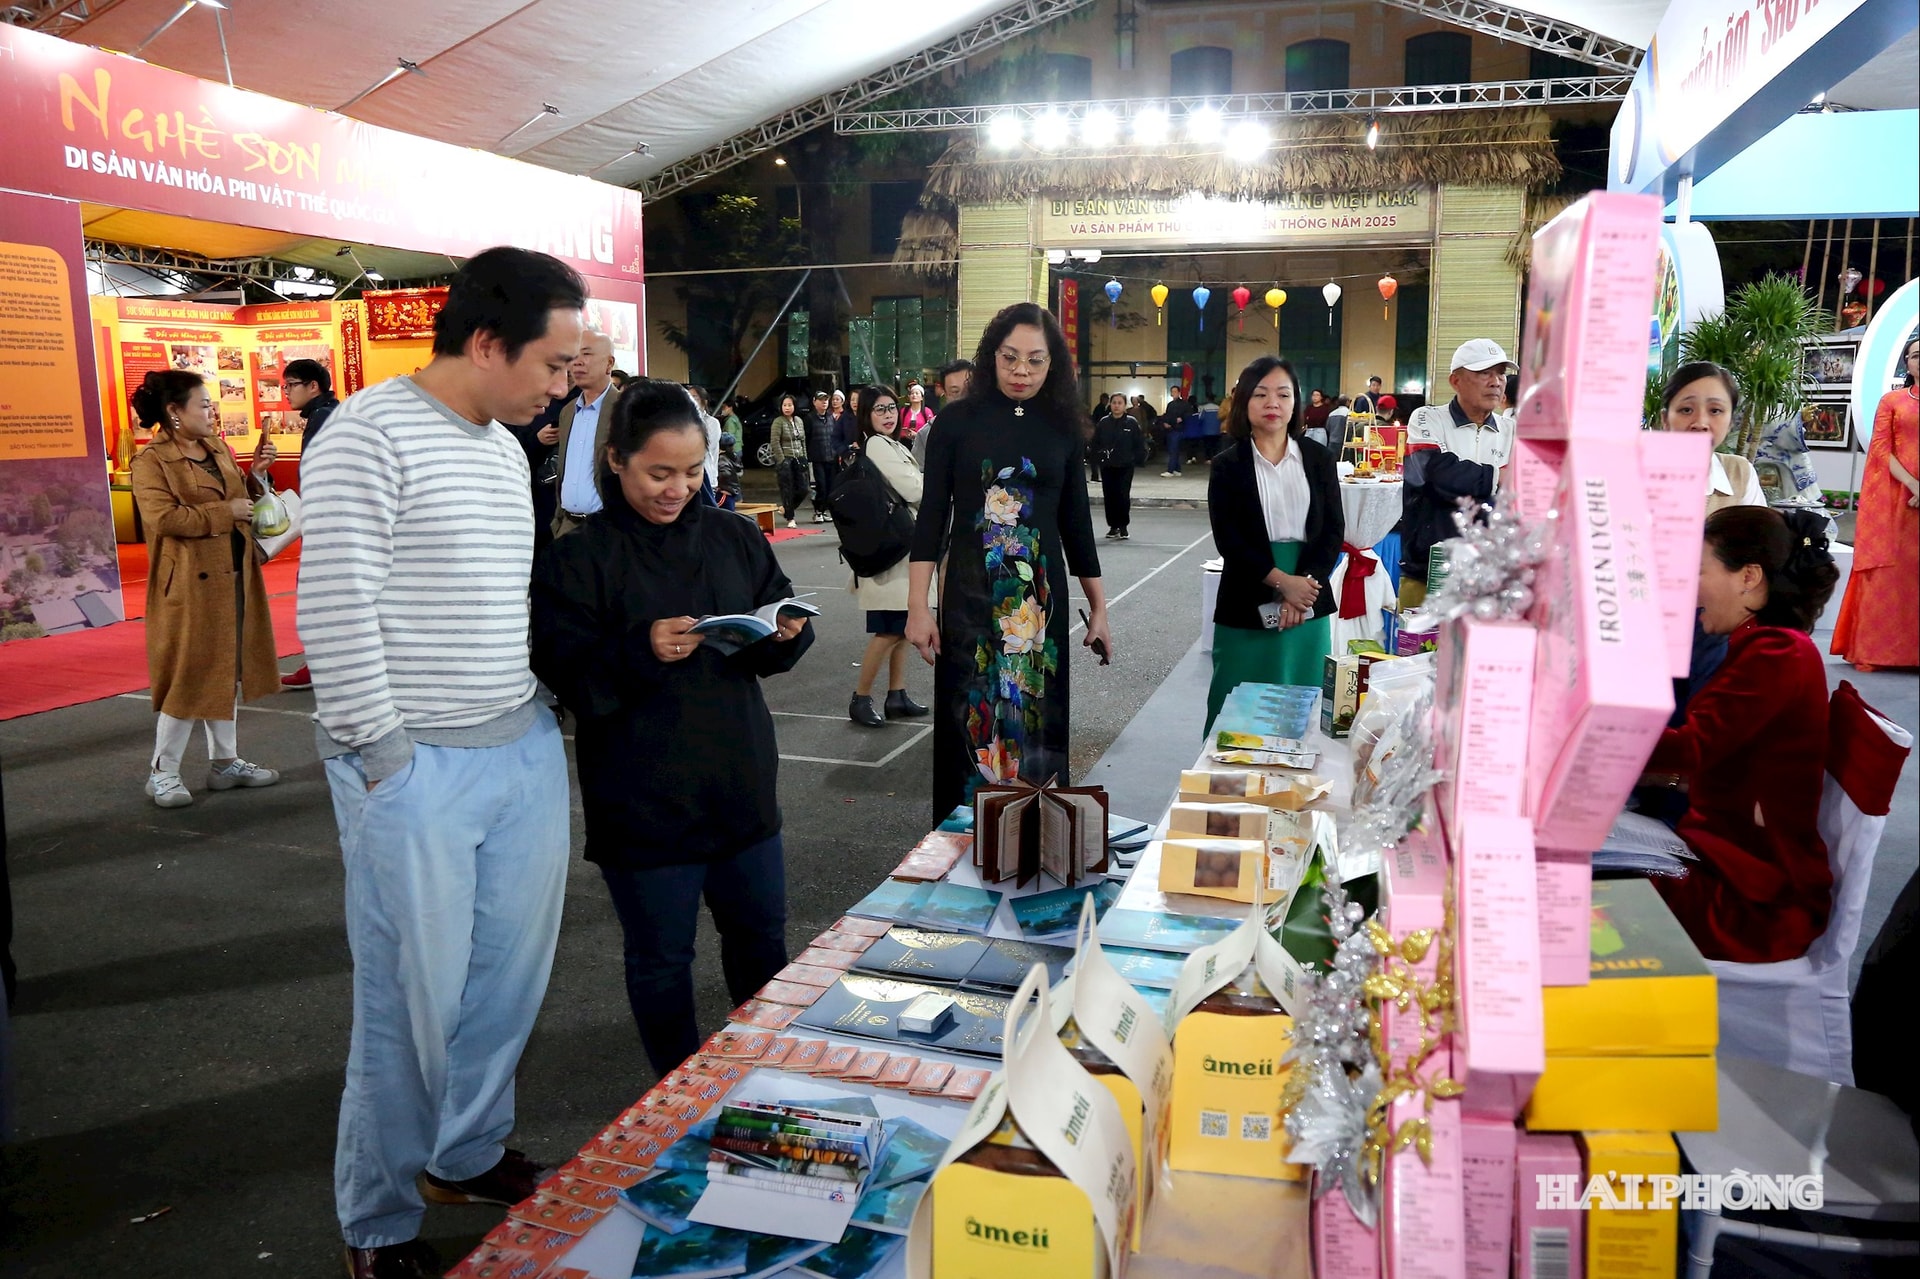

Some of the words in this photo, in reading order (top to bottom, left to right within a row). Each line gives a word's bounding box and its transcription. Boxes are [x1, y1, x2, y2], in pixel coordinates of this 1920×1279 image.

[64, 145, 89, 171] DI
[91, 149, 138, 180] SẢN
[139, 160, 184, 189] VĂN
[185, 166, 227, 196] HÓA
[228, 177, 257, 202] PHI
[258, 182, 295, 210] VẬT
[1051, 199, 1069, 216] DI
[1376, 189, 1418, 208] NAM
[1070, 221, 1087, 235] VÀ
[1090, 220, 1115, 234] SẢN
[1118, 217, 1154, 234] PHẨM
[1280, 213, 1328, 230] THỐNG
[1331, 215, 1361, 229] NĂM
[1364, 215, 1397, 228] 2025
[1585, 479, 1612, 551] LYCHEE
[1594, 556, 1621, 643] FROZEN
[1202, 1054, 1274, 1076] ameii
[965, 1215, 1050, 1250] ameii
